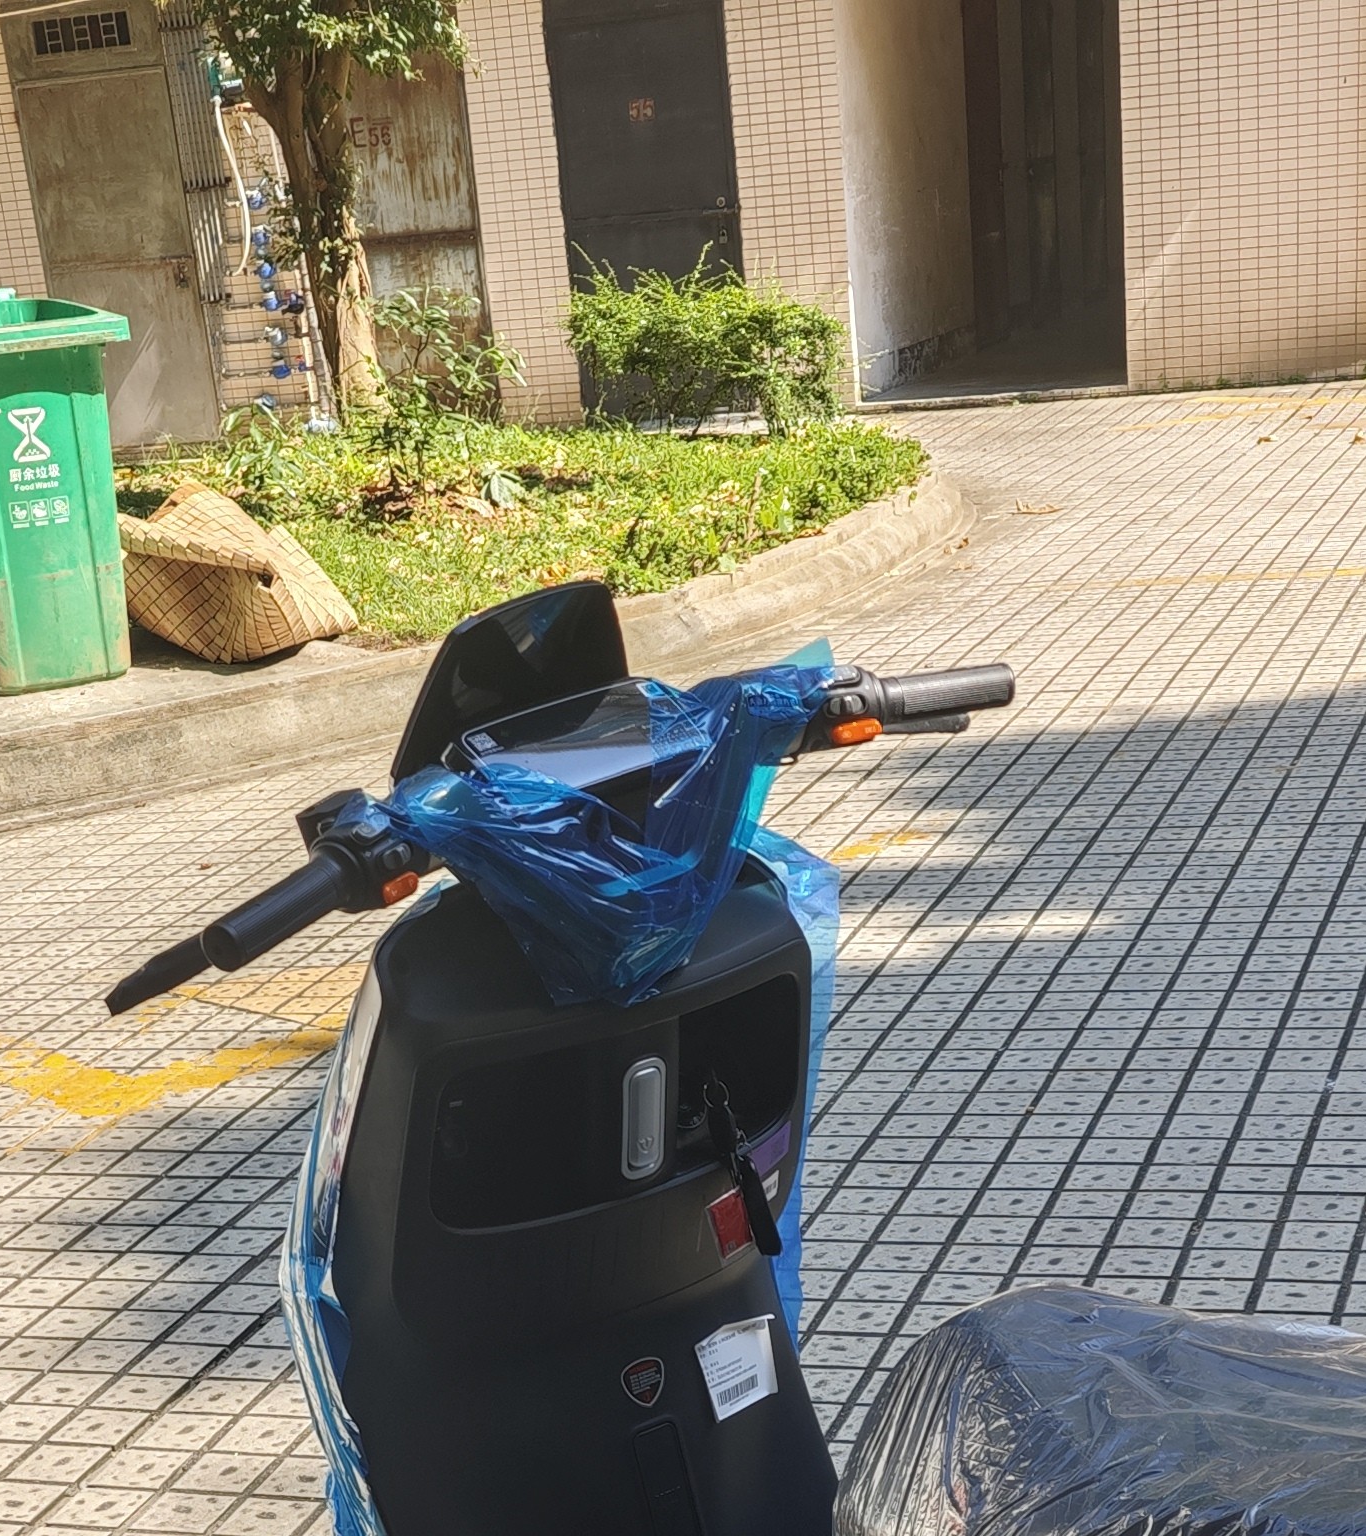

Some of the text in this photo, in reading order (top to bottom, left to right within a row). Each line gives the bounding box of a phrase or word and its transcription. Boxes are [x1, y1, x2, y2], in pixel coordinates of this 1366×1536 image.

[630, 98, 655, 120] 55
[350, 116, 392, 148] E56
[9, 463, 61, 482] 厨余垃圾
[13, 480, 59, 492] Food Waste
